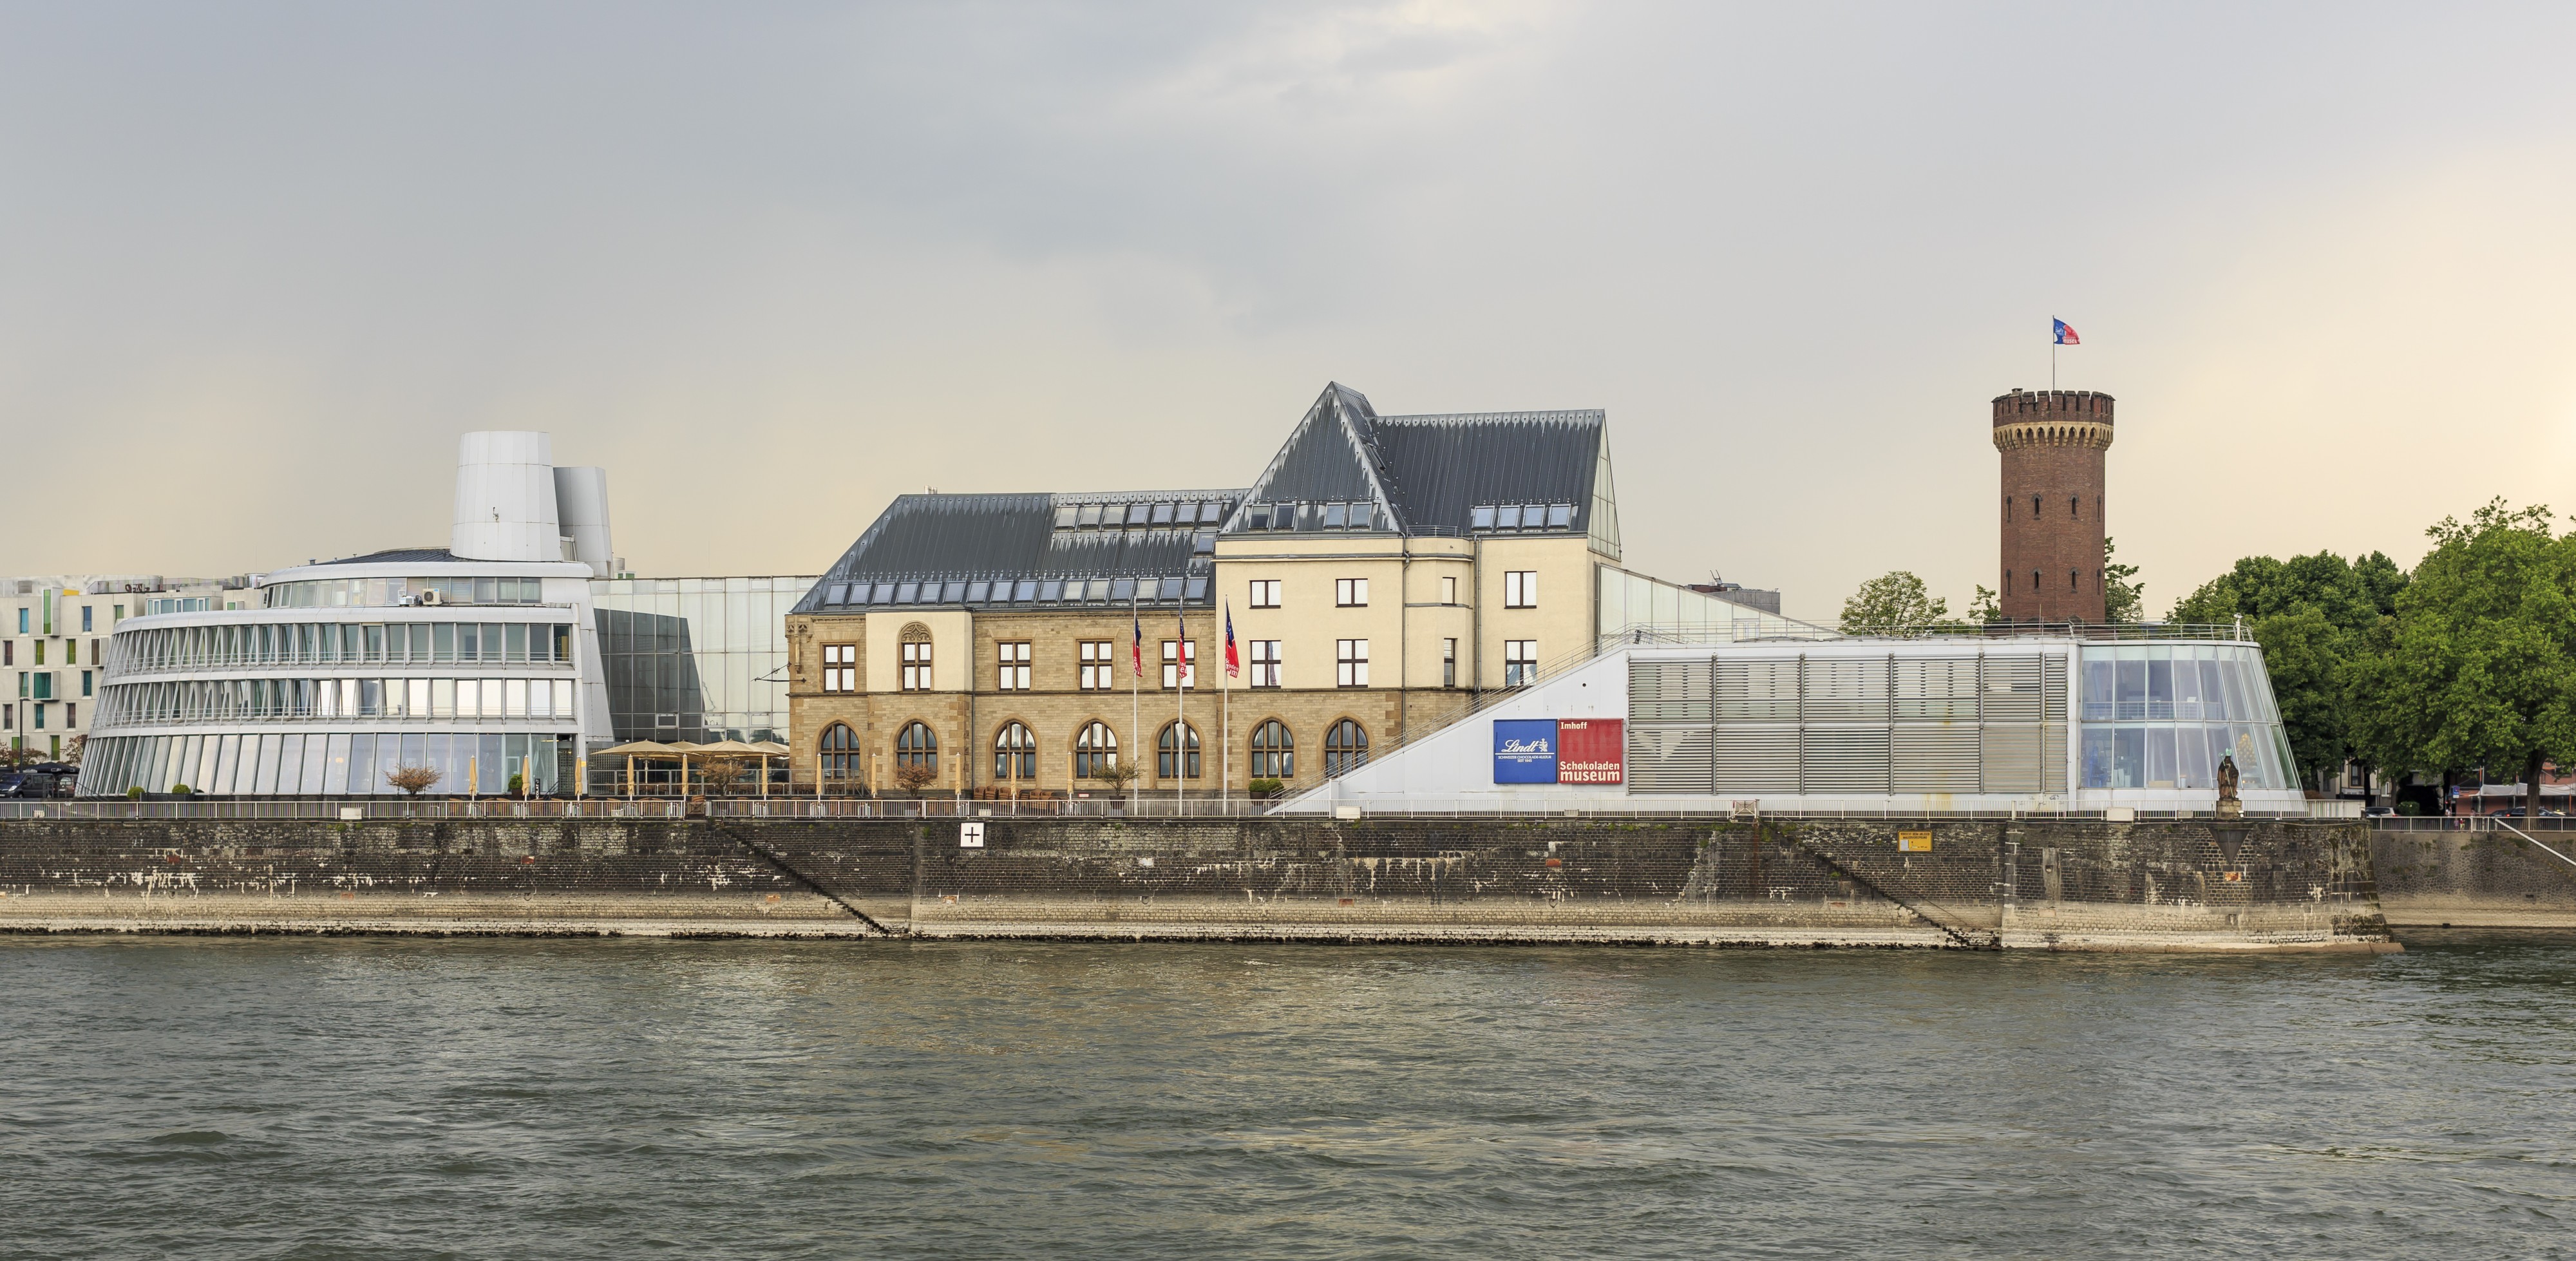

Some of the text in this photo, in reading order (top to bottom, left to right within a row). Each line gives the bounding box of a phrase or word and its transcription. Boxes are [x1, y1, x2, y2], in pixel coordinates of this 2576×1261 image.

[1560, 721, 1587, 730] Imhoff
[1501, 739, 1540, 752] Lindt
[1560, 761, 1620, 770] Schokoladen
[1560, 770, 1620, 781] museum
